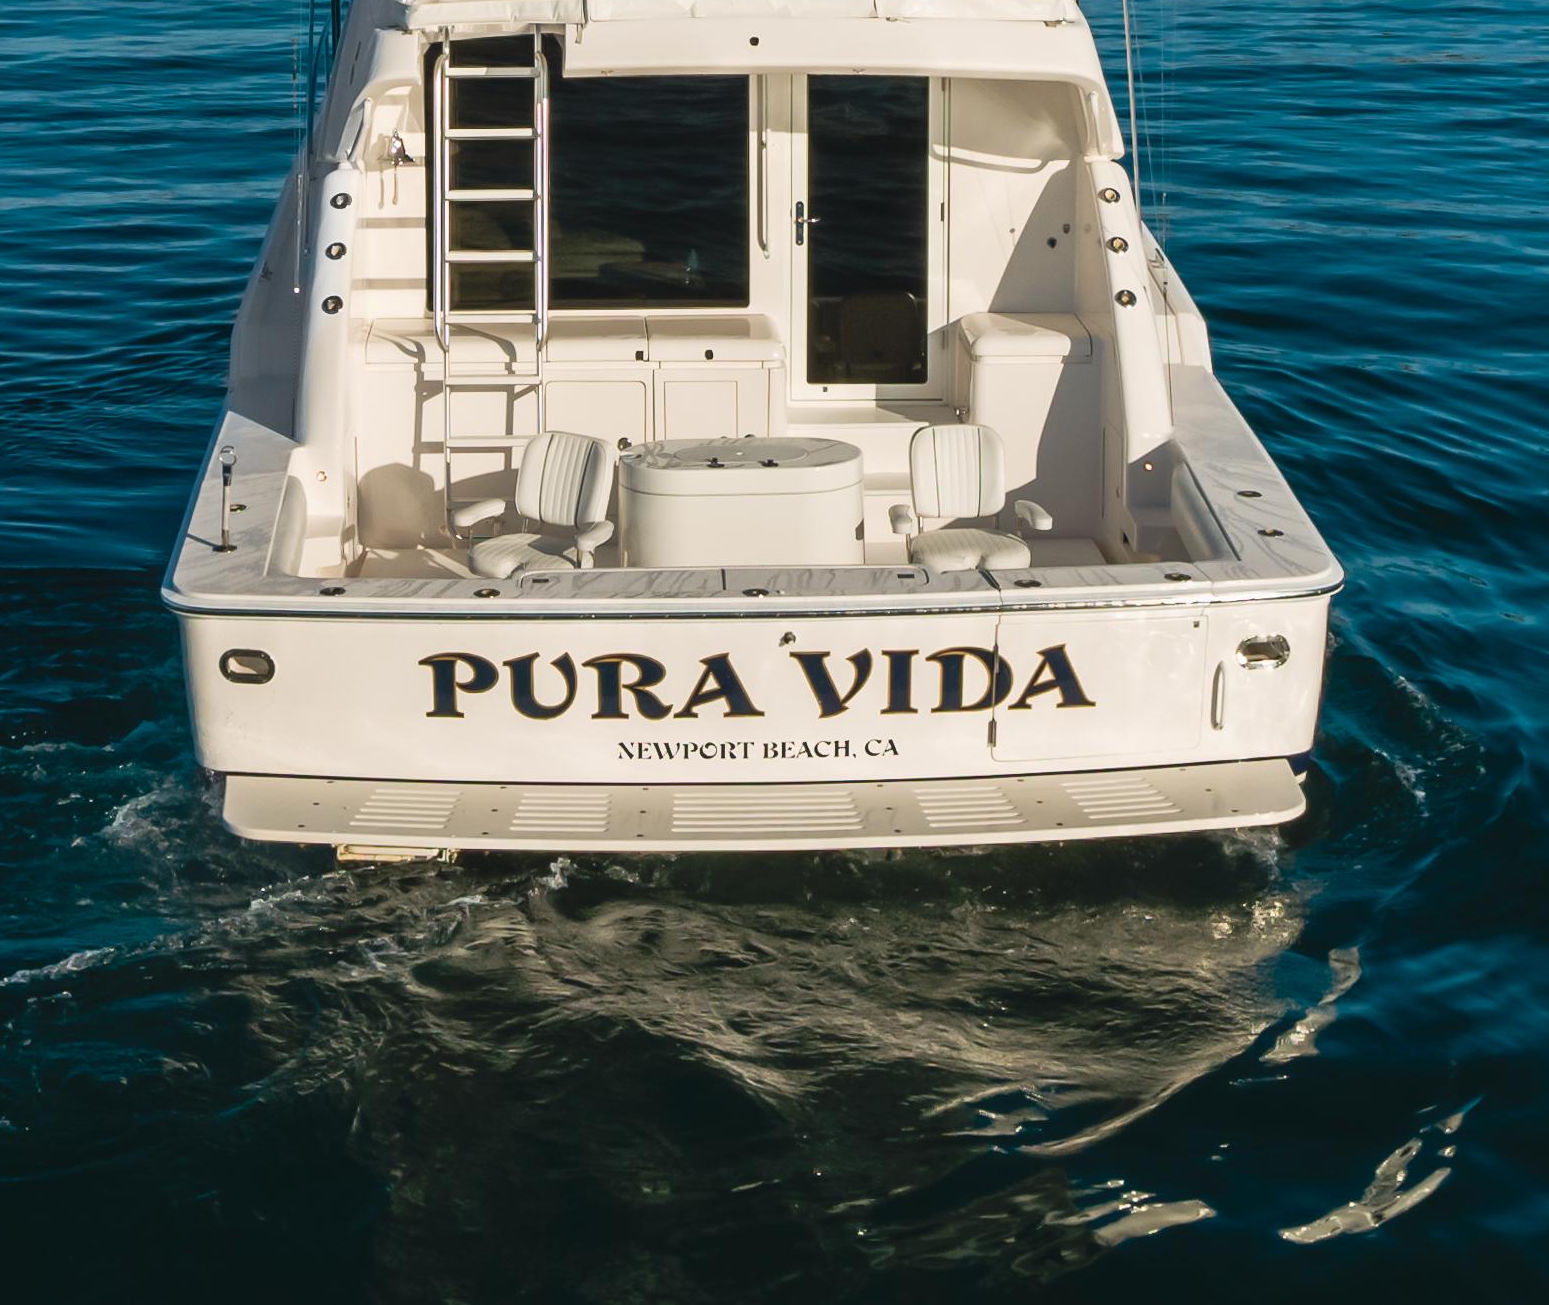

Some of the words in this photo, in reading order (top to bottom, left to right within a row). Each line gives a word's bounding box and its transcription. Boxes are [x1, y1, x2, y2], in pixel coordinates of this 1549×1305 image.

[417, 651, 765, 721] PURA
[789, 643, 1097, 719] VIDA
[618, 741, 755, 760] NEWPORT
[763, 740, 857, 760] BEACH,
[864, 739, 899, 758] CA
